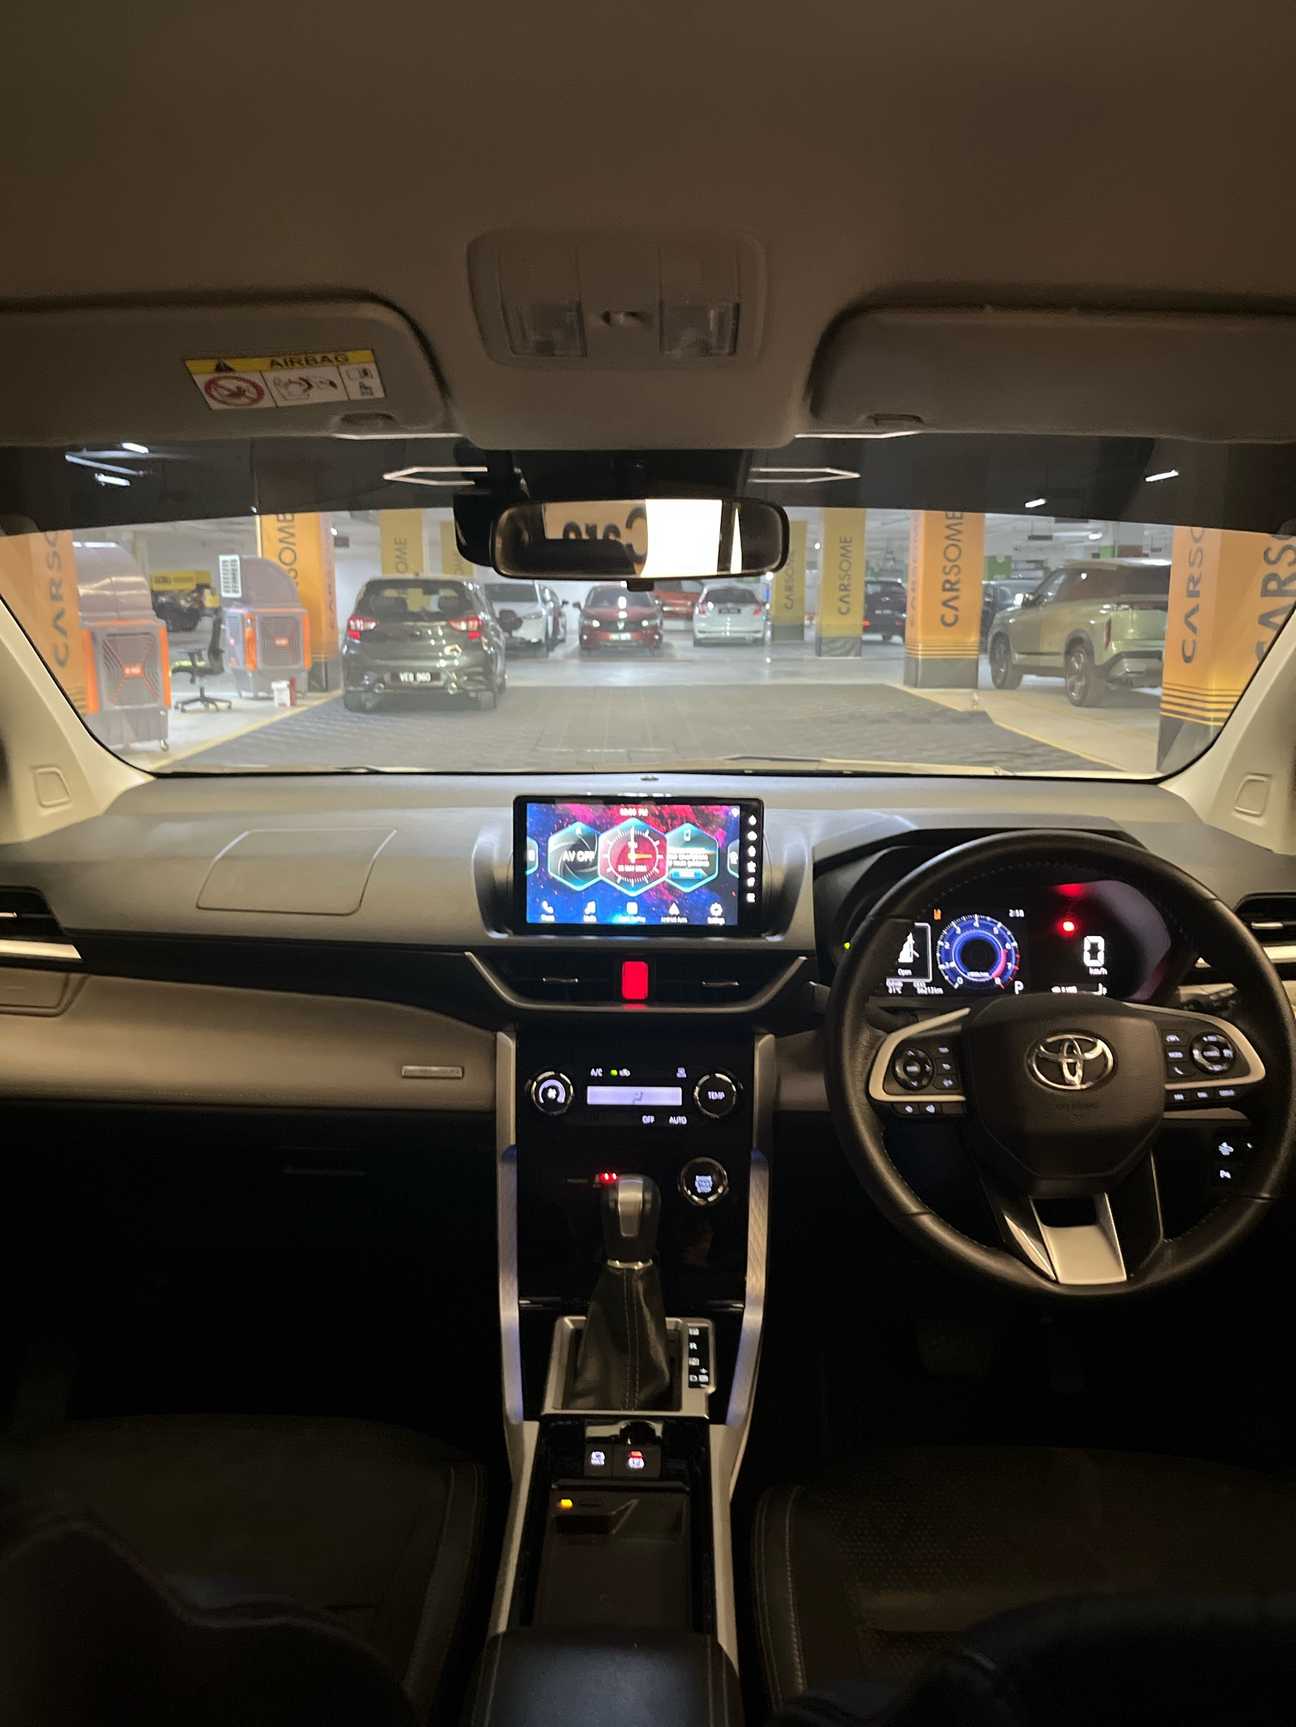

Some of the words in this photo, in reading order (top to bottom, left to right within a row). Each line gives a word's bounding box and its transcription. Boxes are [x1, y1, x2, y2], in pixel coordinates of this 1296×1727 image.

[271, 354, 347, 371] AIRBAG
[838, 536, 852, 615] CARSOME
[563, 850, 576, 862] AV
[576, 850, 595, 862] OFF
[1083, 936, 1105, 966] 0
[1014, 981, 1024, 994] P
[590, 1068, 603, 1077] A/C
[708, 1091, 725, 1100] TEMP
[642, 1115, 655, 1124] OFF
[668, 1116, 687, 1125] AUTO
